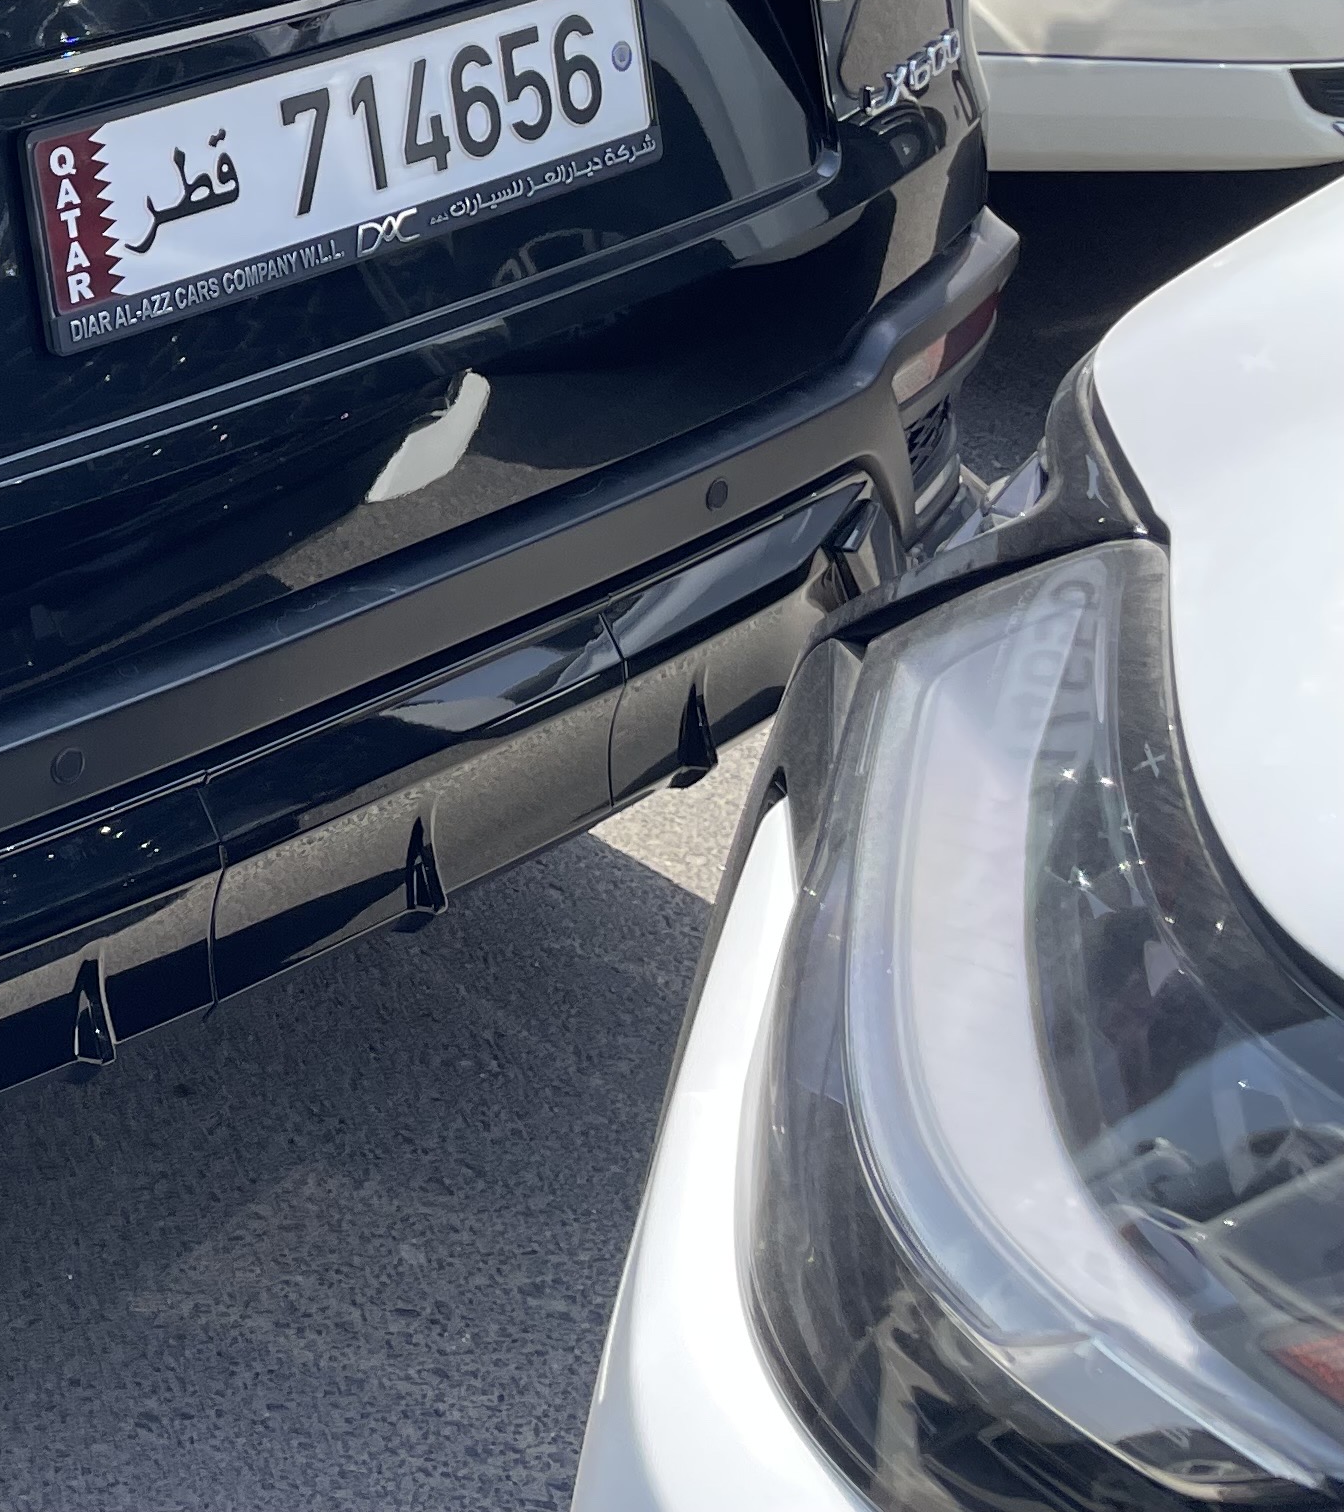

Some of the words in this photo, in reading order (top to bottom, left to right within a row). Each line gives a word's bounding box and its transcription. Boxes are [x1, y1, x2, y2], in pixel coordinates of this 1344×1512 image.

[123, 127, 240, 255] قطر
[279, 13, 604, 218] 714656
[49, 145, 95, 305] QATAR
[69, 310, 113, 343] DIAR
[115, 291, 174, 331] AL-AZZ
[174, 276, 221, 310] CARS
[222, 249, 298, 296] COMPANY
